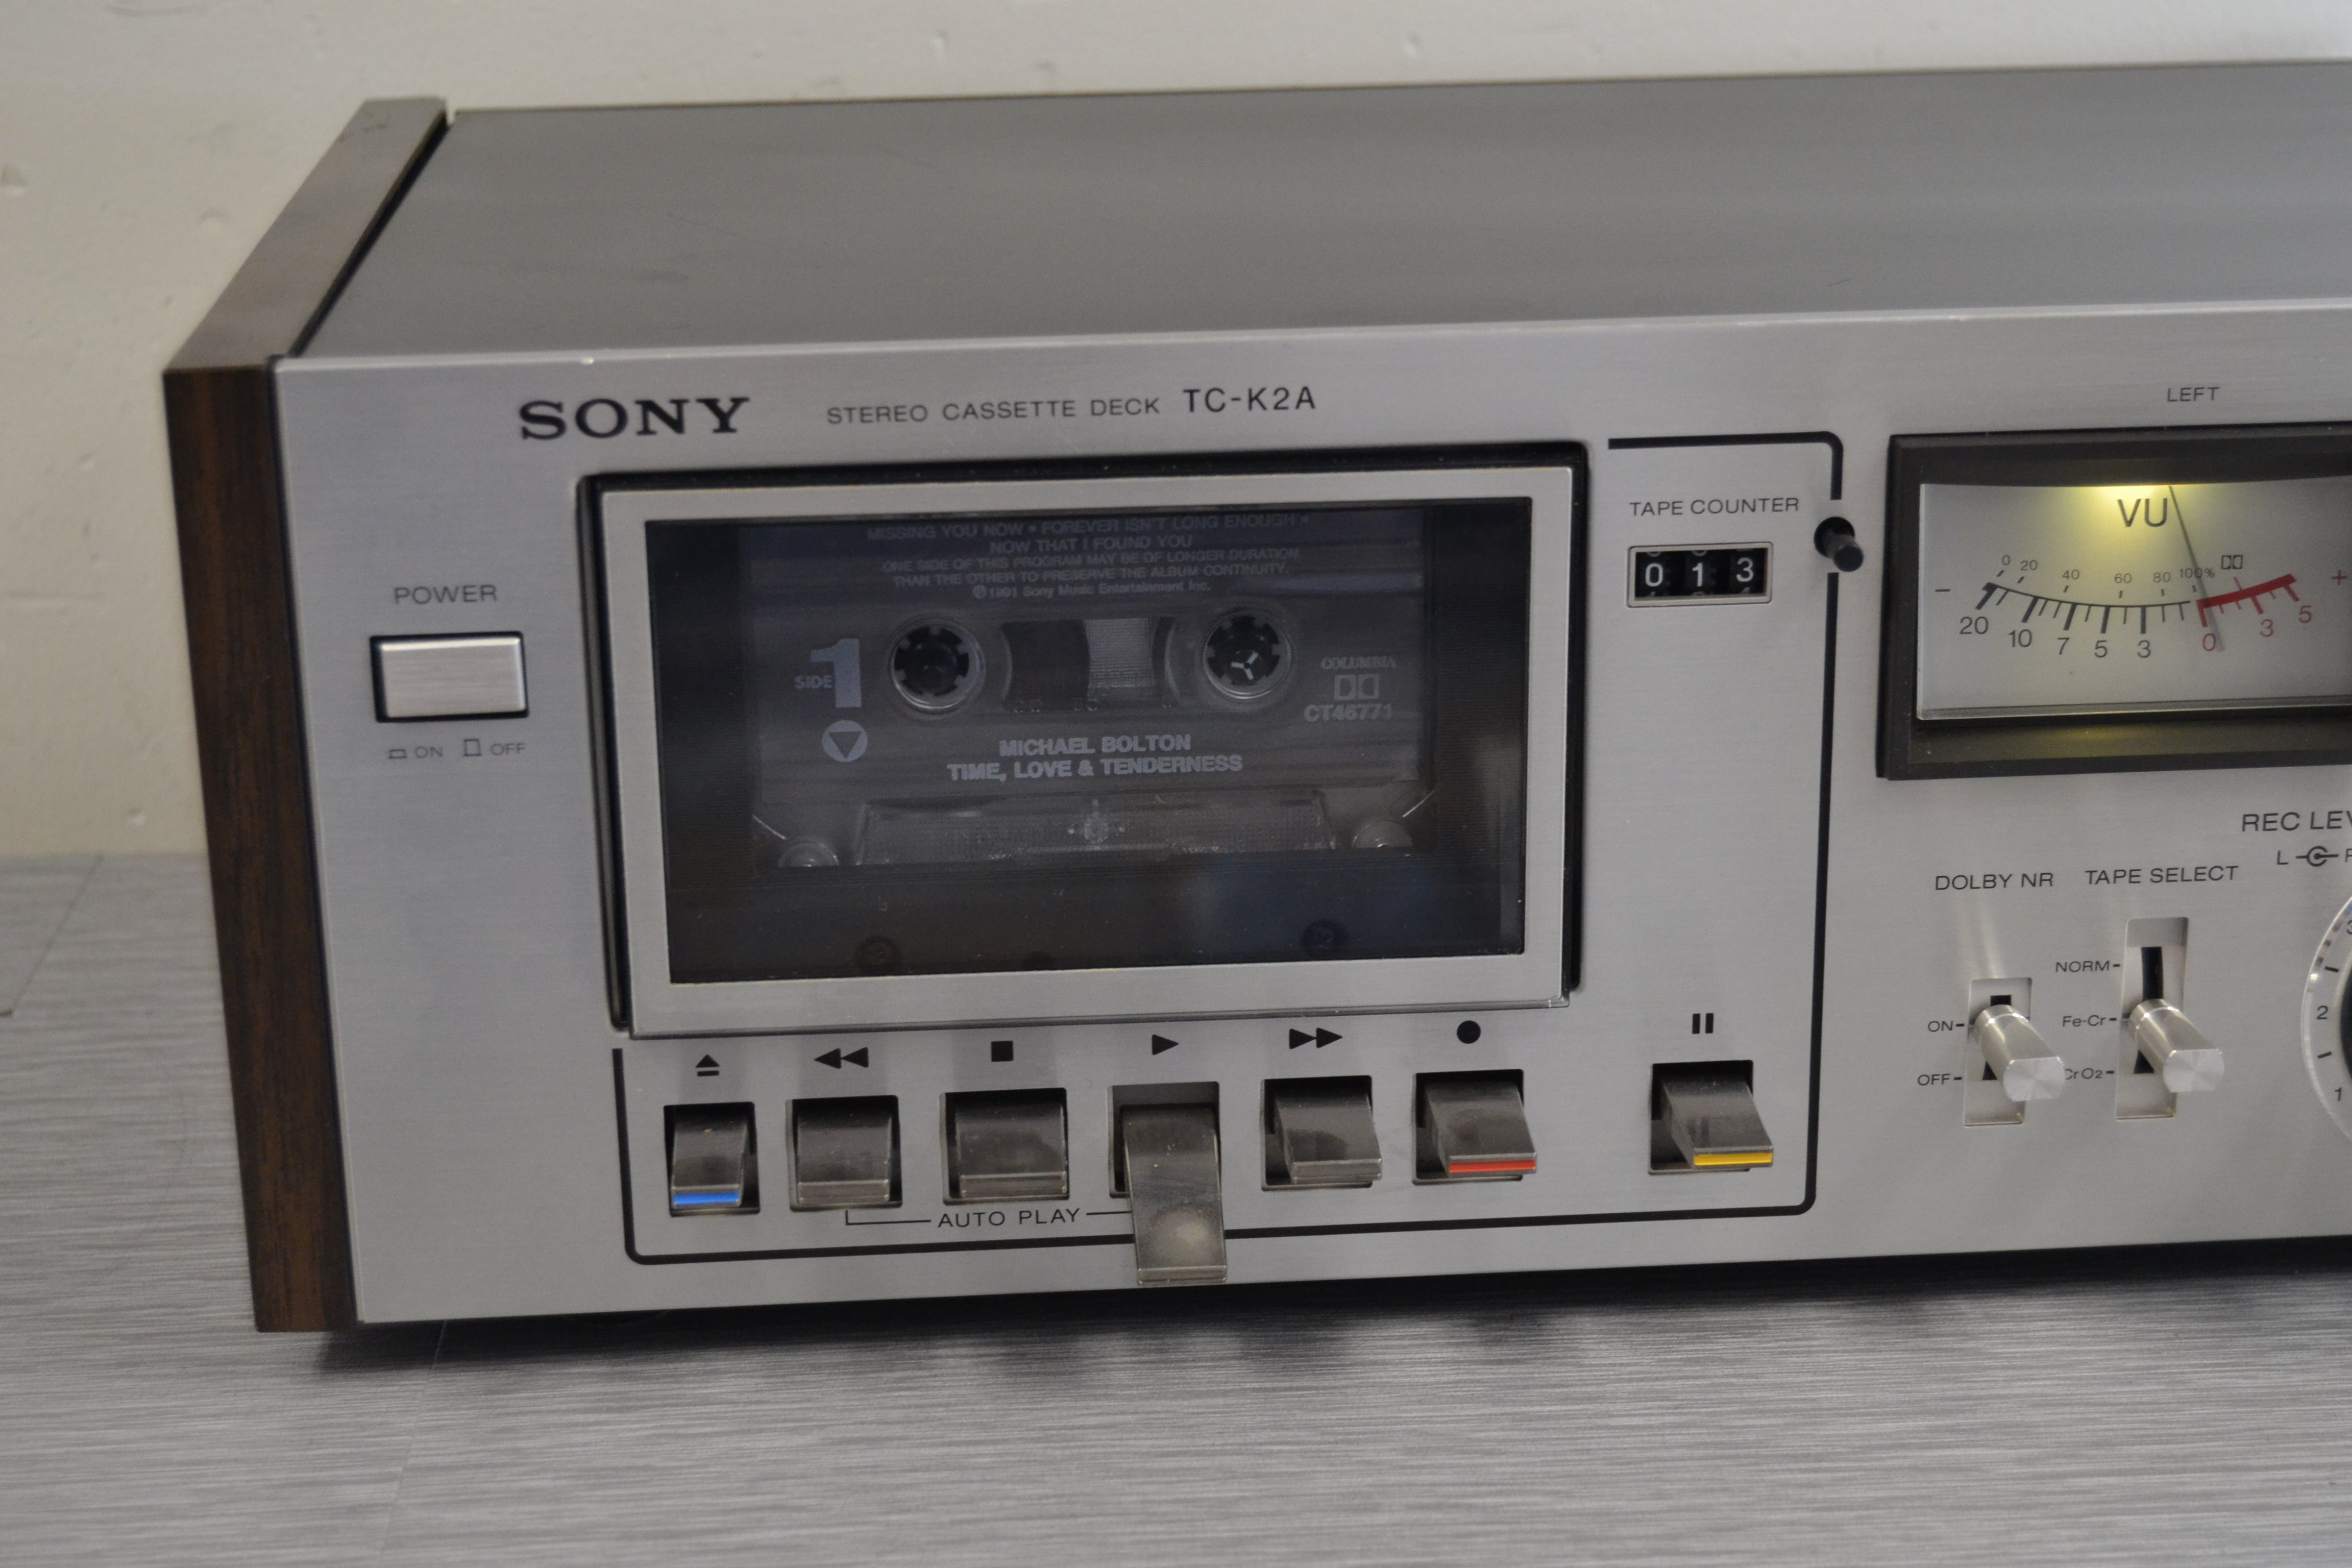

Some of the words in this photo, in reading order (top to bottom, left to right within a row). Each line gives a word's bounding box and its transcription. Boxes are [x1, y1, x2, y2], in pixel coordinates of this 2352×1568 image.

[2166, 386, 2220, 403] LEFT
[826, 403, 928, 425] STEREO
[942, 399, 1076, 422] CASSETTE
[1090, 396, 1161, 418] DECK
[1183, 385, 1317, 414] TC-K2A
[519, 396, 749, 441] SONY
[1629, 501, 1683, 517] TAPE
[1690, 497, 1799, 514] COUNTER
[2117, 498, 2168, 528] VU
[867, 525, 937, 540] MISSING
[941, 524, 978, 538] YOU
[983, 523, 1024, 536] NOW
[1041, 520, 1119, 534] FOREVER
[1172, 516, 1219, 530] LONG
[1224, 513, 1294, 528] ENOUGH
[989, 539, 1032, 554] NOW
[1035, 537, 1079, 552] THAT
[1093, 535, 1151, 550] FOUND
[1156, 534, 1193, 548] YOU
[953, 558, 972, 570] OF
[1086, 552, 1117, 565] MAY
[1143, 551, 1163, 563] OF
[1167, 549, 1224, 562] LONGER
[1228, 547, 1300, 560] DURATION
[934, 573, 963, 585] THE
[966, 572, 1015, 584] OTHER
[1019, 571, 1039, 582] TO
[1119, 567, 1147, 579] THE
[1150, 566, 1198, 578] ALBUM
[2001, 554, 2011, 566] 0
[2020, 559, 2038, 571] 20
[2062, 569, 2080, 580] 40
[2114, 572, 2132, 584] 60
[2152, 571, 2171, 583] 80
[394, 584, 498, 604] POWER
[1023, 585, 1055, 599] Sony
[1959, 616, 1989, 635] 20
[2007, 629, 2032, 648] 10
[2056, 636, 2070, 655] 7
[2094, 640, 2108, 658] 5
[2137, 640, 2151, 658] 3
[2202, 632, 2217, 652] 0
[2260, 618, 2274, 638] 3
[2298, 604, 2313, 624] 5
[794, 675, 833, 690] SIDE
[810, 638, 862, 708] 1
[414, 746, 444, 759] ON
[490, 742, 526, 756] OFF
[998, 737, 1096, 757] MICHAEL
[1101, 734, 1191, 754] BOLTON
[946, 763, 1007, 782] TIME,
[1014, 760, 1072, 779] LOVE
[1078, 760, 1095, 777] &
[1099, 755, 1243, 776] TENDERNESS
[2241, 811, 2300, 832] REC
[2276, 850, 2289, 865] L
[1934, 872, 2013, 891] DOLBY
[2021, 872, 2054, 888] NR
[2085, 868, 2142, 886] TAPE
[2149, 865, 2239, 884] SELECT
[2055, 960, 2111, 973] NORM
[2062, 1015, 2106, 1027] Fe-Cr
[2316, 1005, 2329, 1020] 2
[1927, 1020, 1954, 1034] ON
[1917, 1073, 1951, 1087] OFF
[2334, 1086, 2343, 1102] 1
[938, 1211, 1006, 1228] AUTO
[1018, 1208, 1080, 1225] PLAY
